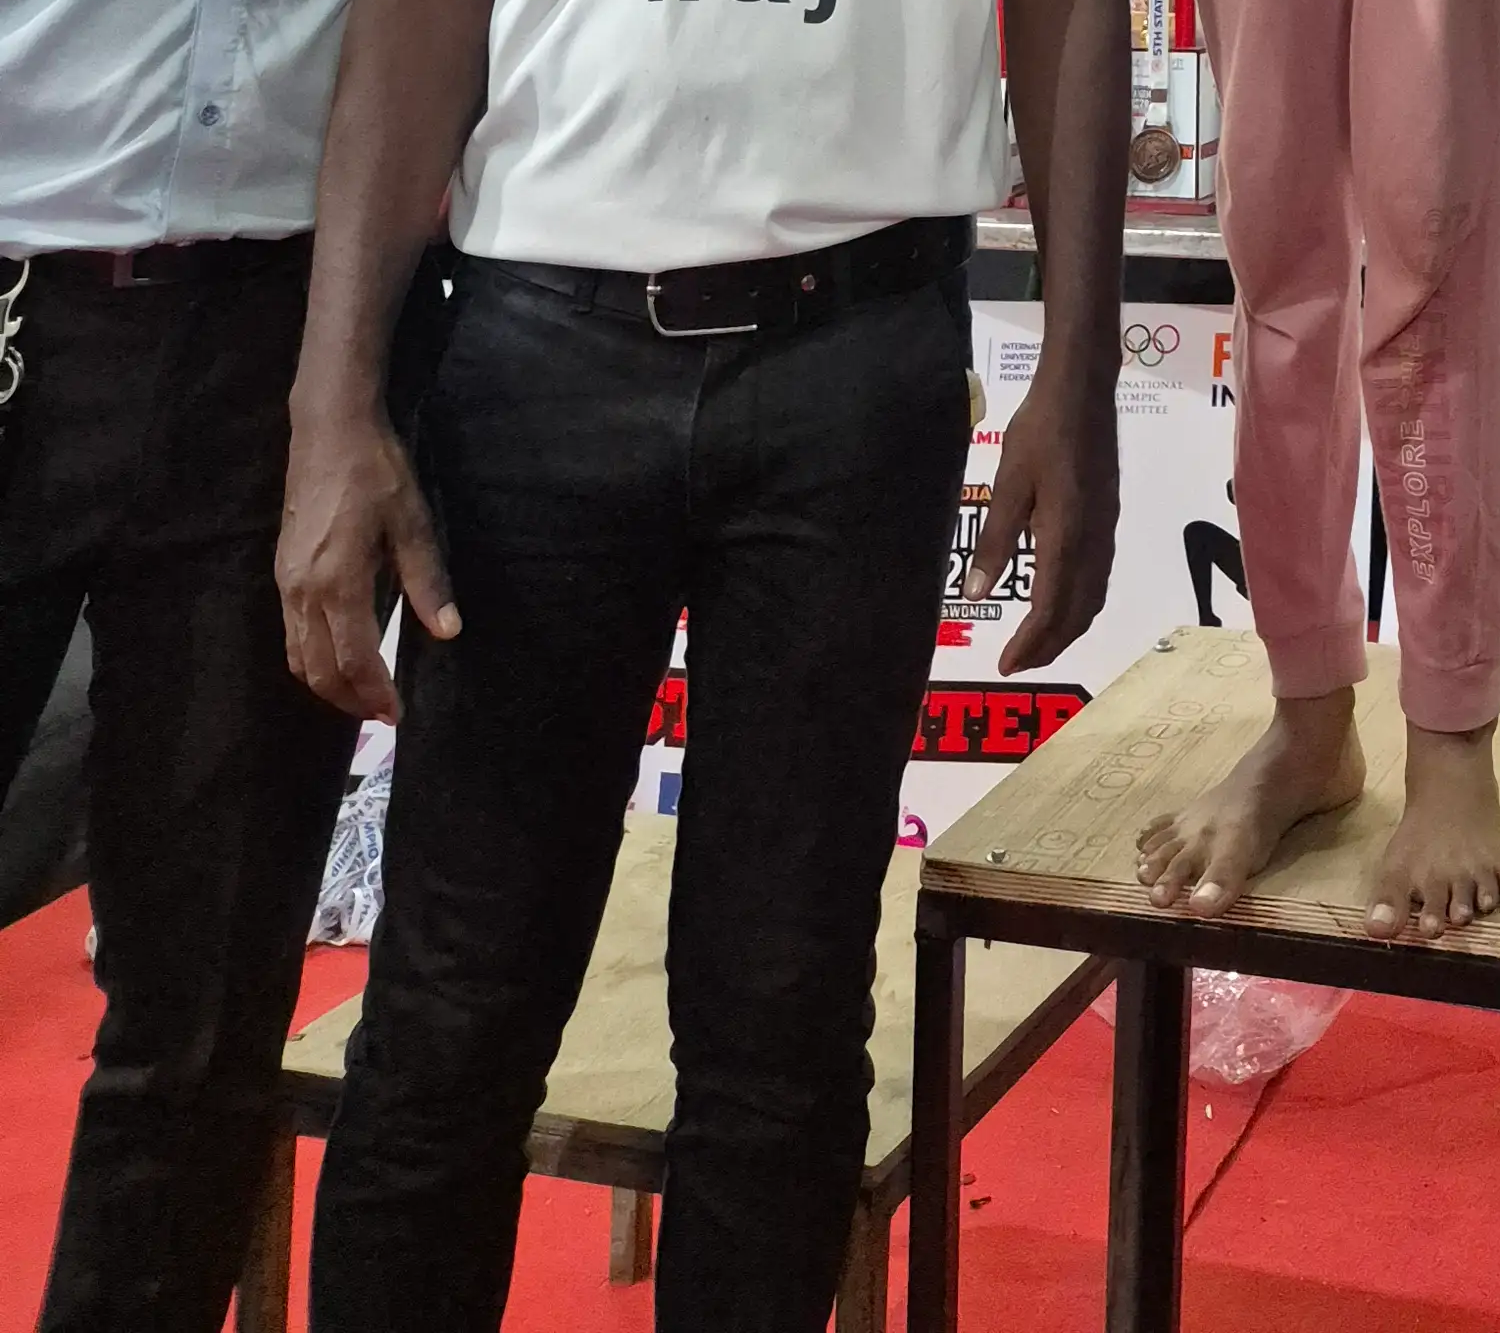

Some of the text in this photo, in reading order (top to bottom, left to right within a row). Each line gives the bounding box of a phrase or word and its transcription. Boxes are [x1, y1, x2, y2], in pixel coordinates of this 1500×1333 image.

[1153, 31, 1163, 56] 5TH
[1000, 363, 1030, 371] SPORTS
[1401, 419, 1433, 585] EXPLORE
